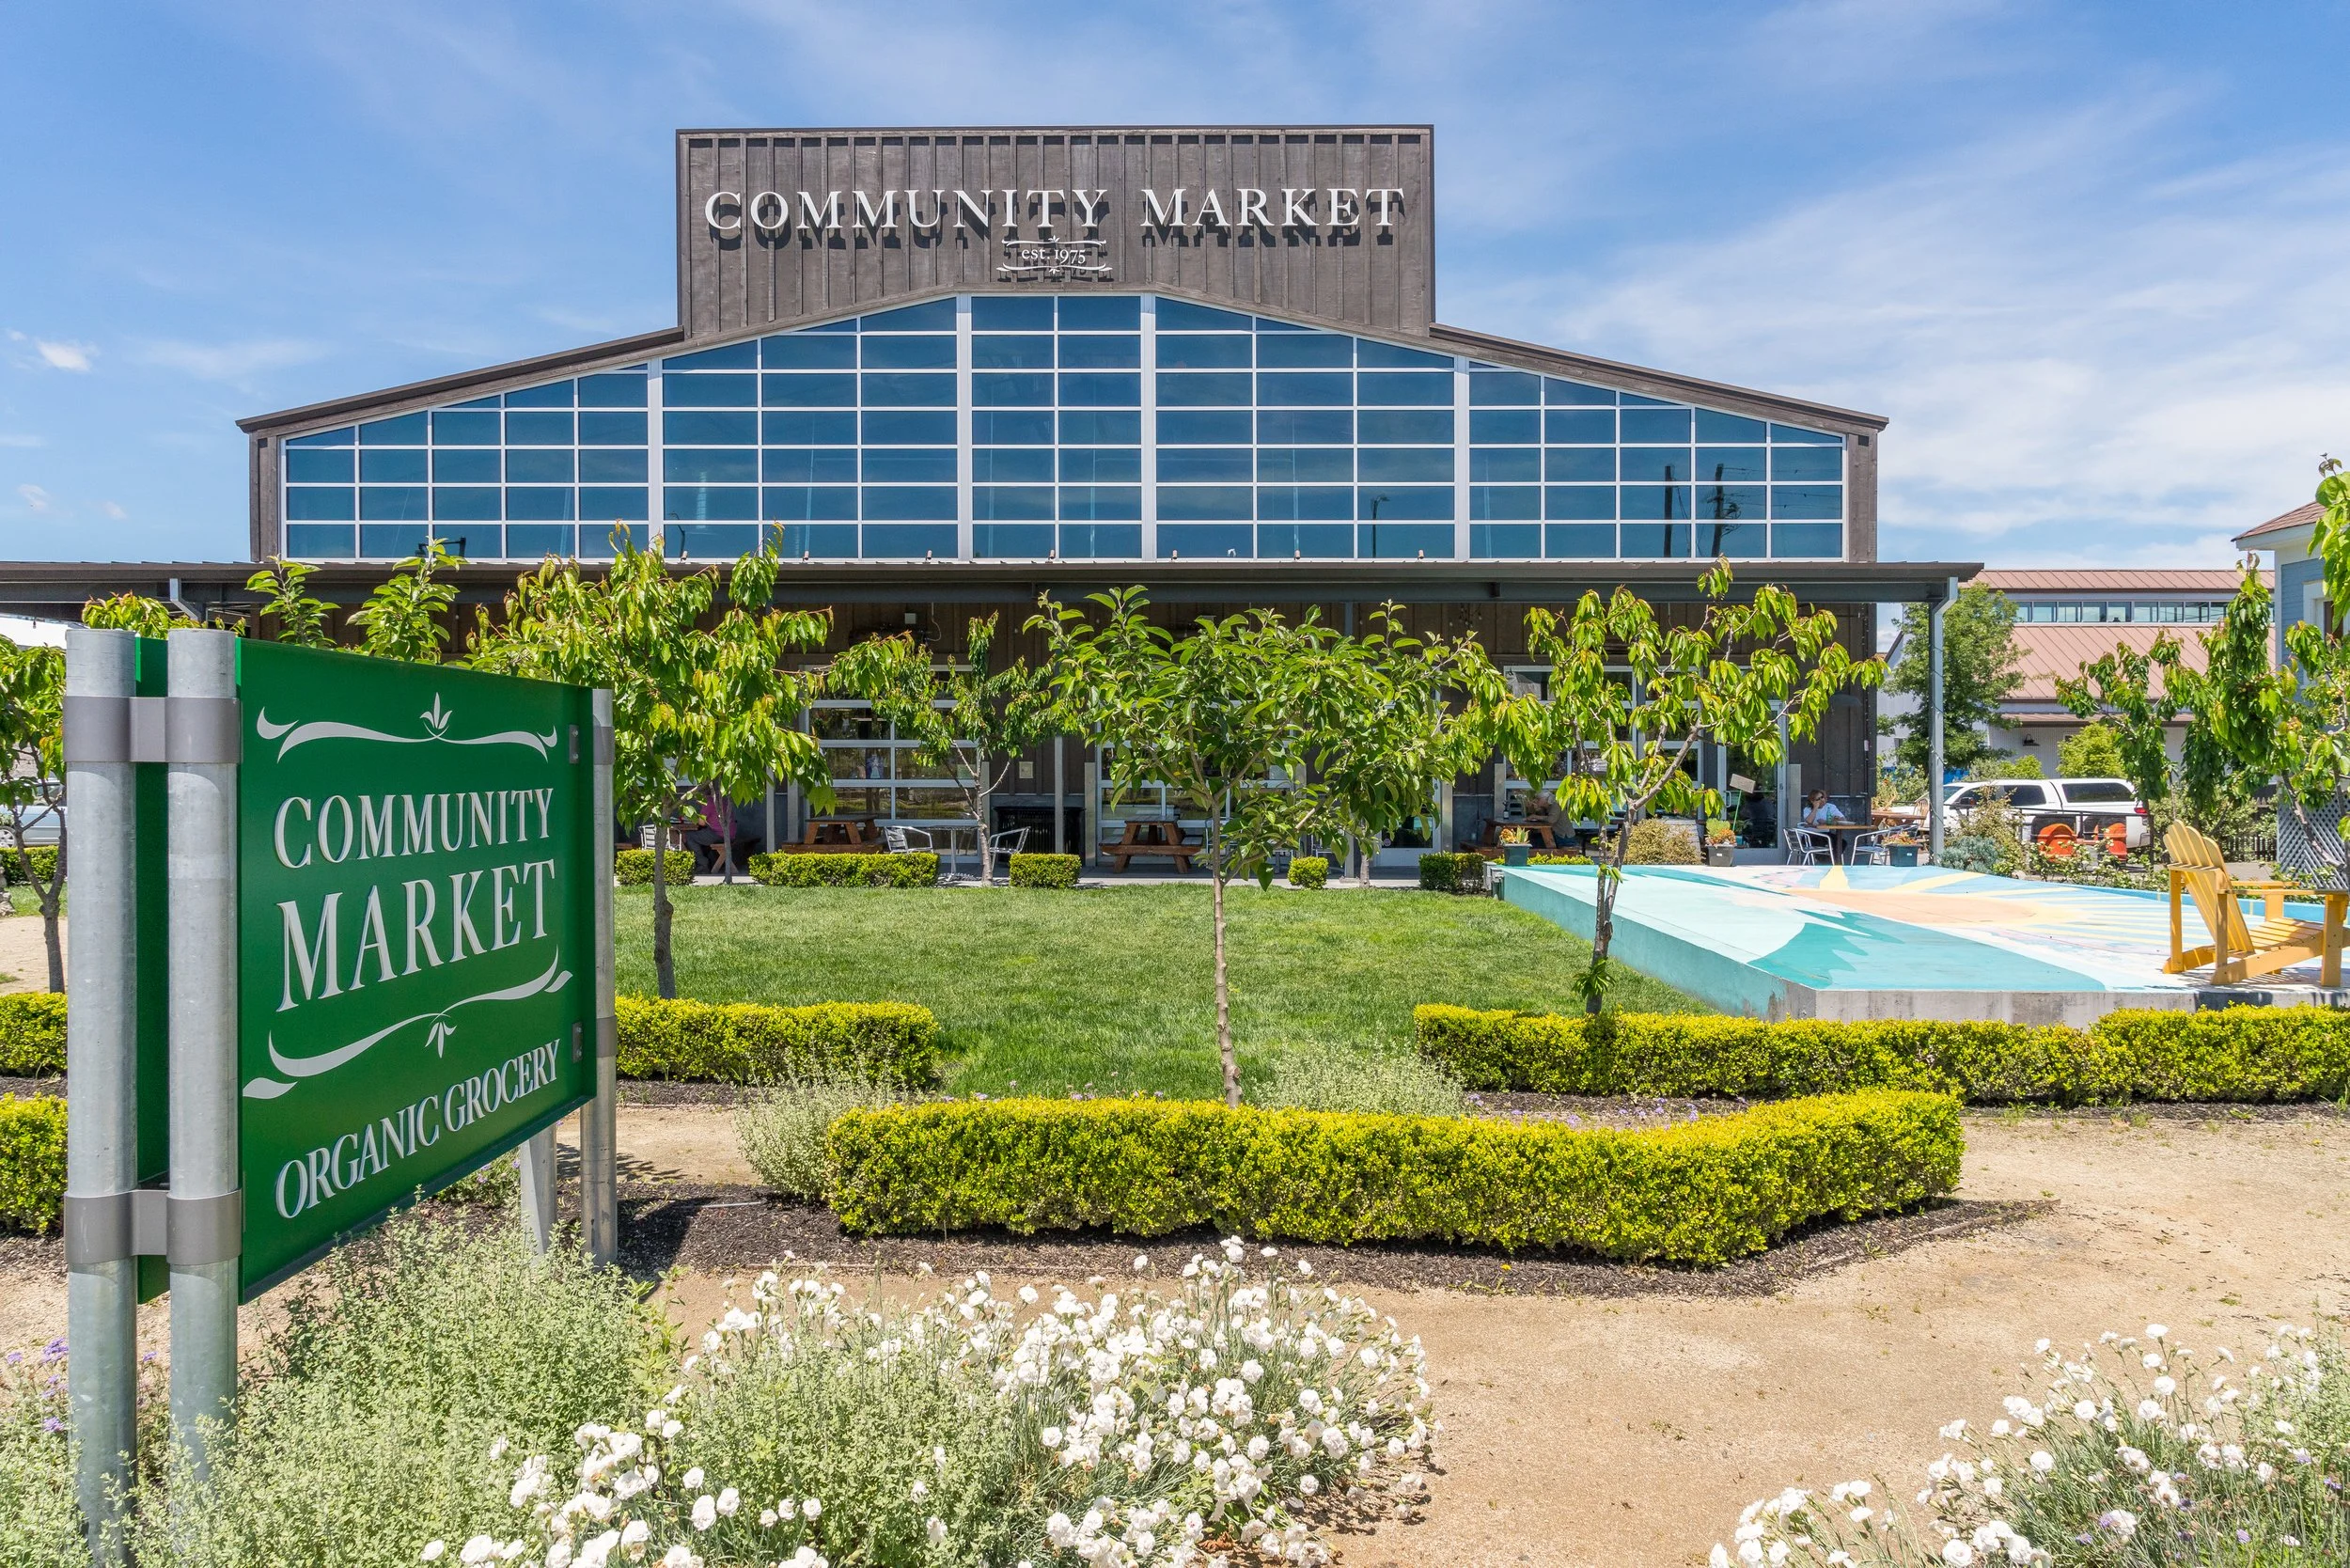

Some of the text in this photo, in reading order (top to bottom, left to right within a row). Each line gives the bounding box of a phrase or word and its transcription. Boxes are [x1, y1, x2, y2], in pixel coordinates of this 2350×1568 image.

[704, 187, 1405, 231] COMMUNITY MARKET
[1021, 247, 1087, 264] est. 1975
[274, 787, 555, 870] COMMUNITY
[276, 857, 556, 1013] MARKET
[275, 1038, 561, 1220] ORGANIC GROCERY
